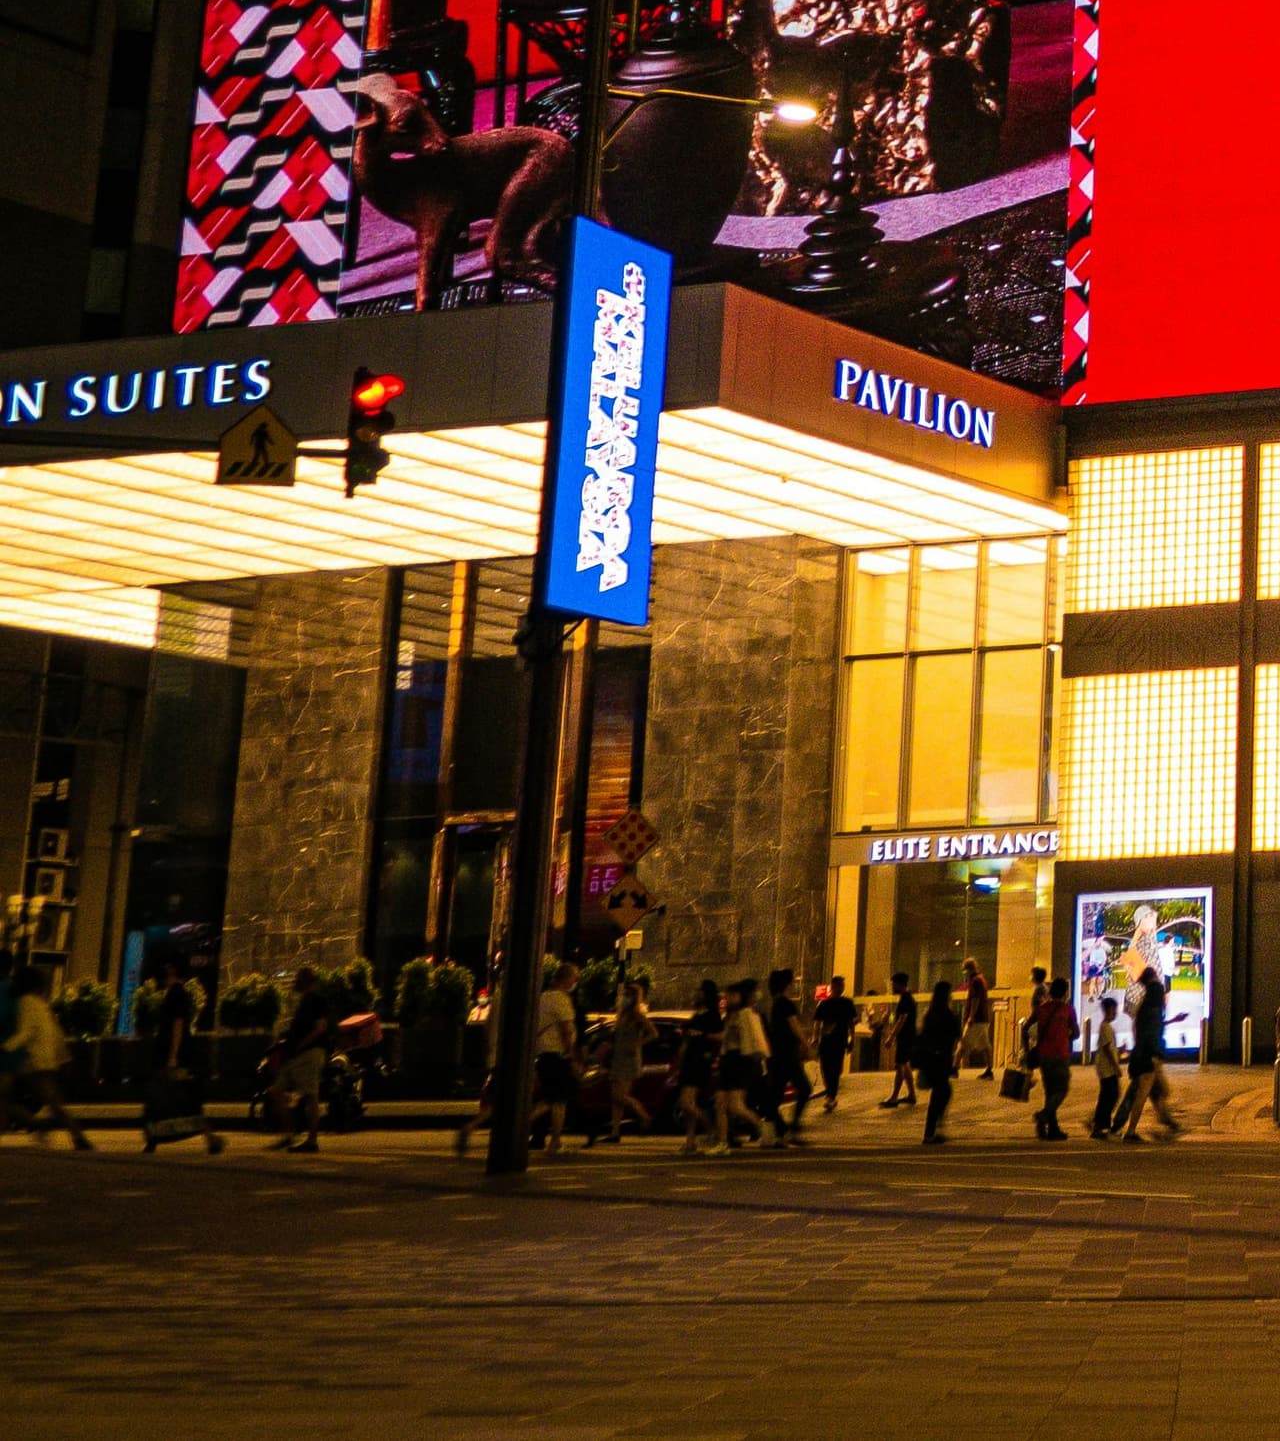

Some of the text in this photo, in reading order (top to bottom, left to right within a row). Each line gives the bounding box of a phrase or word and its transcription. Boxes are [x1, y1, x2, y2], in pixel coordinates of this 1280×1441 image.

[69, 360, 272, 417] SUITES
[838, 359, 995, 448] PAVILION
[575, 288, 625, 573] MALAYSIA
[871, 829, 1061, 862] ELITE ENTRANCE
